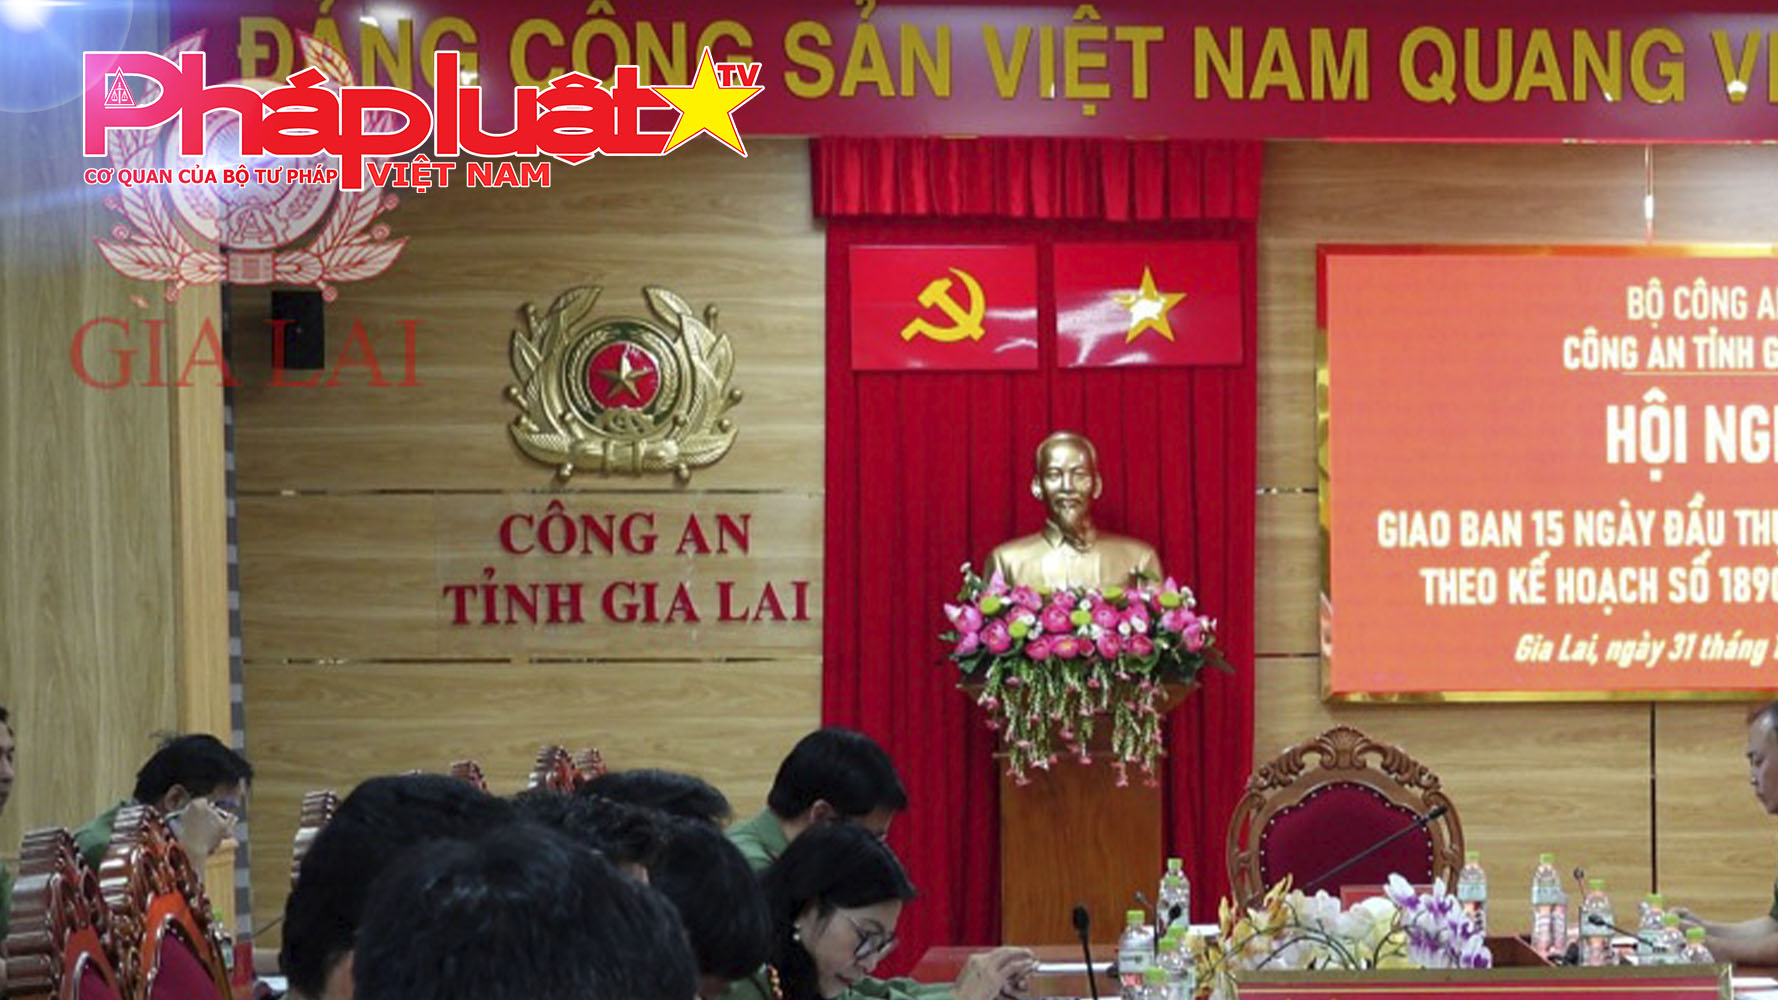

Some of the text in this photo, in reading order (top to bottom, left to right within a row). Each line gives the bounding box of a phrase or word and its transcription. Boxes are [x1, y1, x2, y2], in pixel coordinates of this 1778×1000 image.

[783, 0, 951, 97] SẢN
[982, 5, 1164, 115] VIỆT
[1195, 28, 1369, 100] NAM
[1400, 28, 1685, 104] QUANG
[1627, 277, 1666, 328] BỘ
[1673, 277, 1747, 320] CÔNG
[1563, 327, 1637, 369] CÔNG
[1647, 336, 1685, 369] AN
[1693, 326, 1752, 369] TỈNH
[1606, 386, 1686, 481] HỘI
[499, 500, 751, 555] CÔNG AN
[1378, 510, 1451, 548] GIAO
[1460, 510, 1522, 548] BAN
[1532, 510, 1563, 547] 15
[1574, 498, 1655, 547] NGÀY
[1663, 493, 1724, 547] ĐẦU
[443, 567, 812, 625] TỈNH GIA LAI
[1421, 568, 1496, 605] THEO
[1508, 550, 1550, 605] KẾ
[1556, 566, 1657, 614] HOẠCH
[1667, 548, 1711, 604] SỐ
[1515, 634, 1558, 662] Gia
[1560, 633, 1600, 664] Lai,
[1606, 630, 1665, 669] ngày
[1668, 633, 1697, 661] 31
[1700, 629, 1767, 667] tháng
